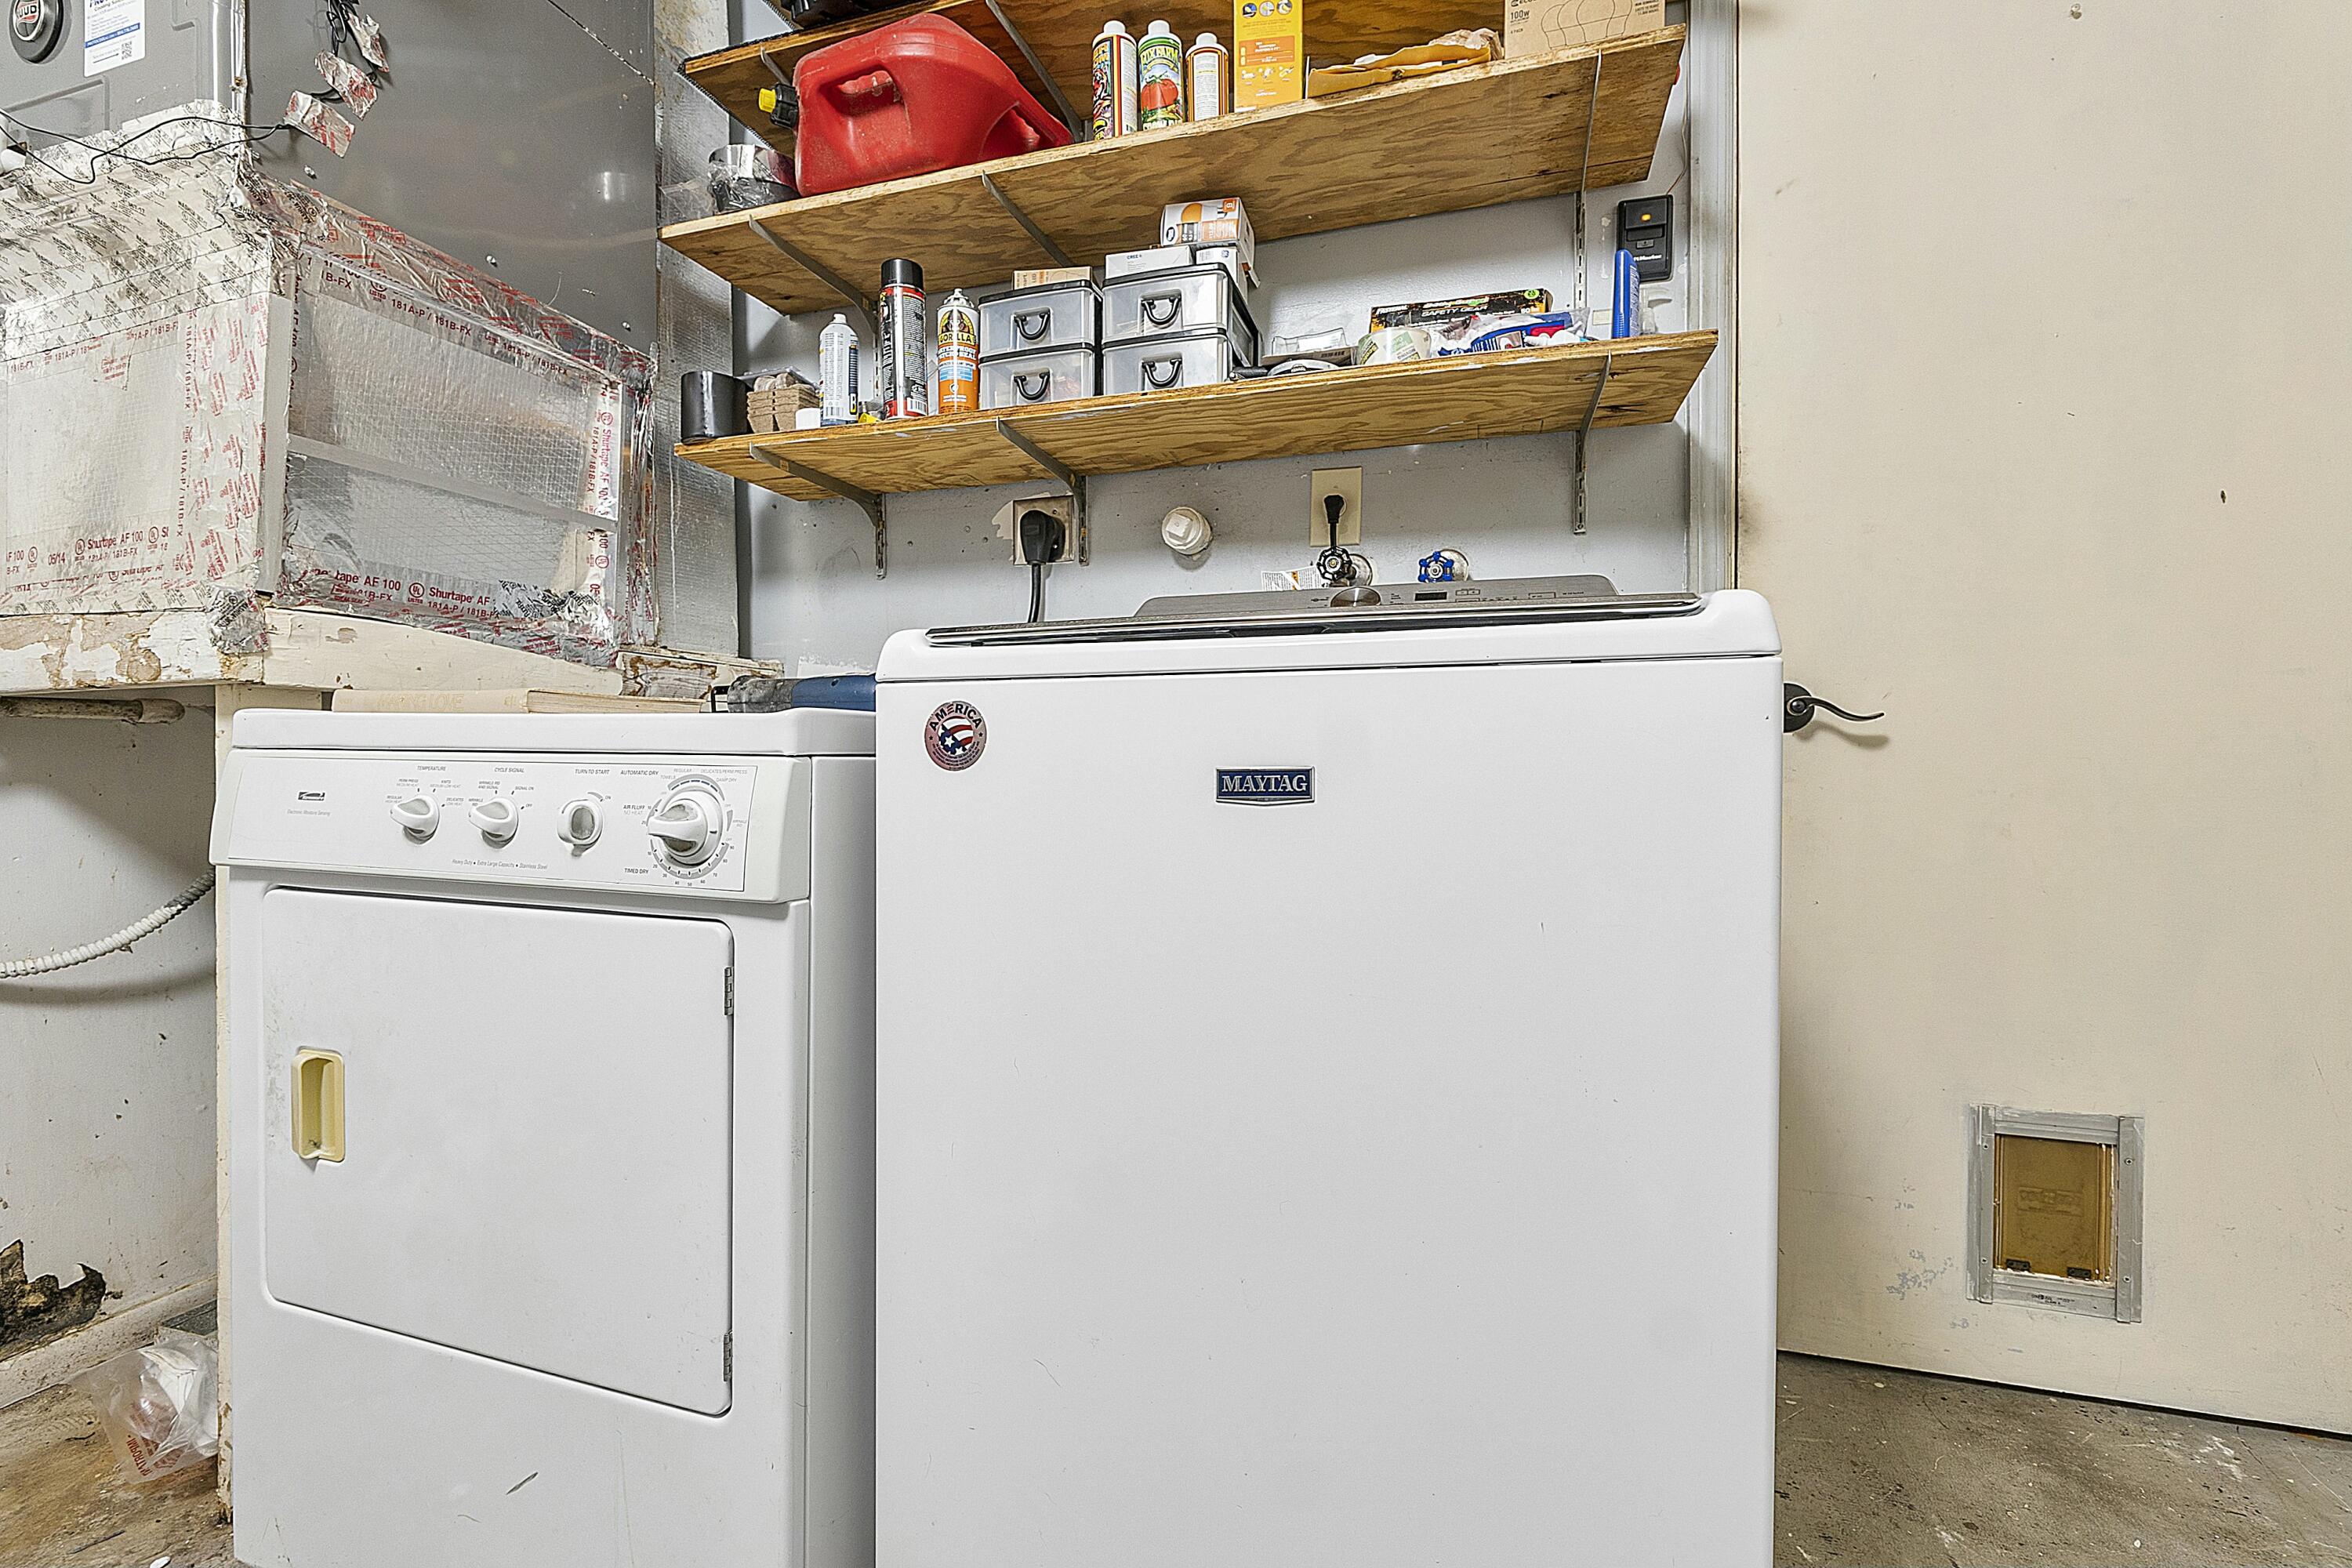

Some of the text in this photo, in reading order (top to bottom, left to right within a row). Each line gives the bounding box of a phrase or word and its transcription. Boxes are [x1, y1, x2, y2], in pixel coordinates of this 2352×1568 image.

[391, 299, 426, 318] 181A-P
[435, 316, 471, 336] 181B-FX
[1421, 308, 1457, 318] SAFETY
[503, 343, 531, 359] 181A-P
[601, 428, 612, 467] Shurtape
[88, 531, 143, 550] Shurtape AF 100
[13, 550, 24, 561] 100
[364, 575, 379, 587] AF
[383, 579, 401, 591] 100
[429, 586, 490, 606] Shurtape AF
[427, 601, 459, 613] 181A-P
[929, 703, 982, 731] AMERICA
[1221, 775, 1308, 792] MAYTAG
